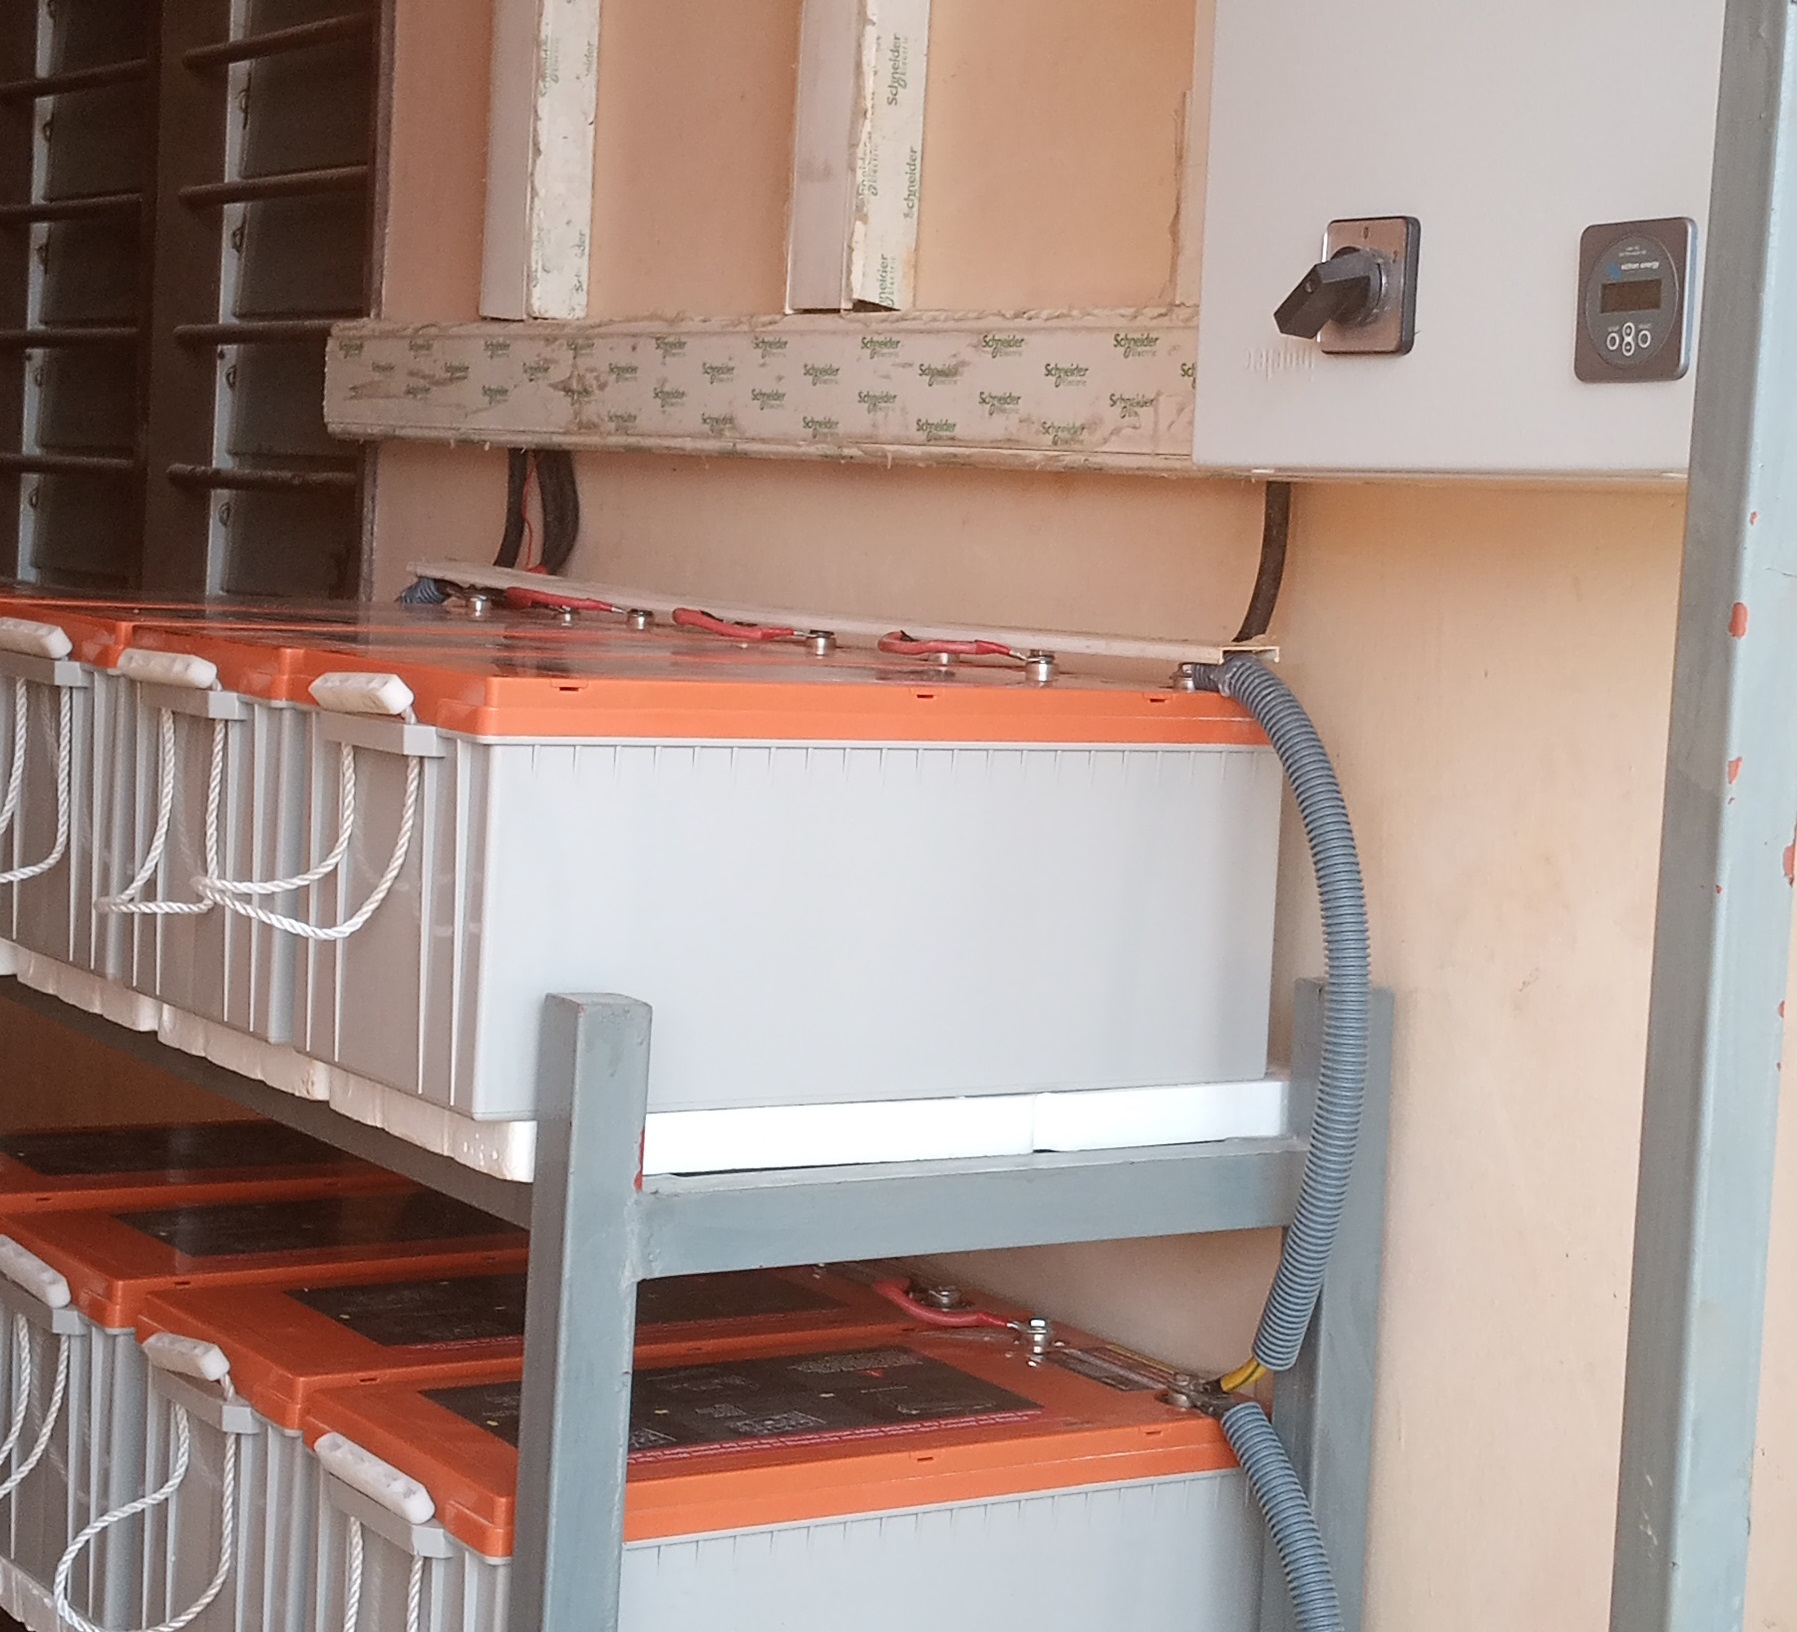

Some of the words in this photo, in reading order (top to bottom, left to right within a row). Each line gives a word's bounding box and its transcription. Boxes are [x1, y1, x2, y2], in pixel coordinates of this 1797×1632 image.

[887, 32, 902, 107] Schneider
[860, 336, 901, 350] Schneider
[982, 334, 1024, 349] Schneider
[1113, 333, 1160, 349] Schneider
[1044, 363, 1090, 378] Schneider
[857, 390, 898, 405] Schneider
[978, 391, 1022, 405] Schneider
[802, 416, 840, 430] Schneider
[916, 418, 957, 433] Schneider
